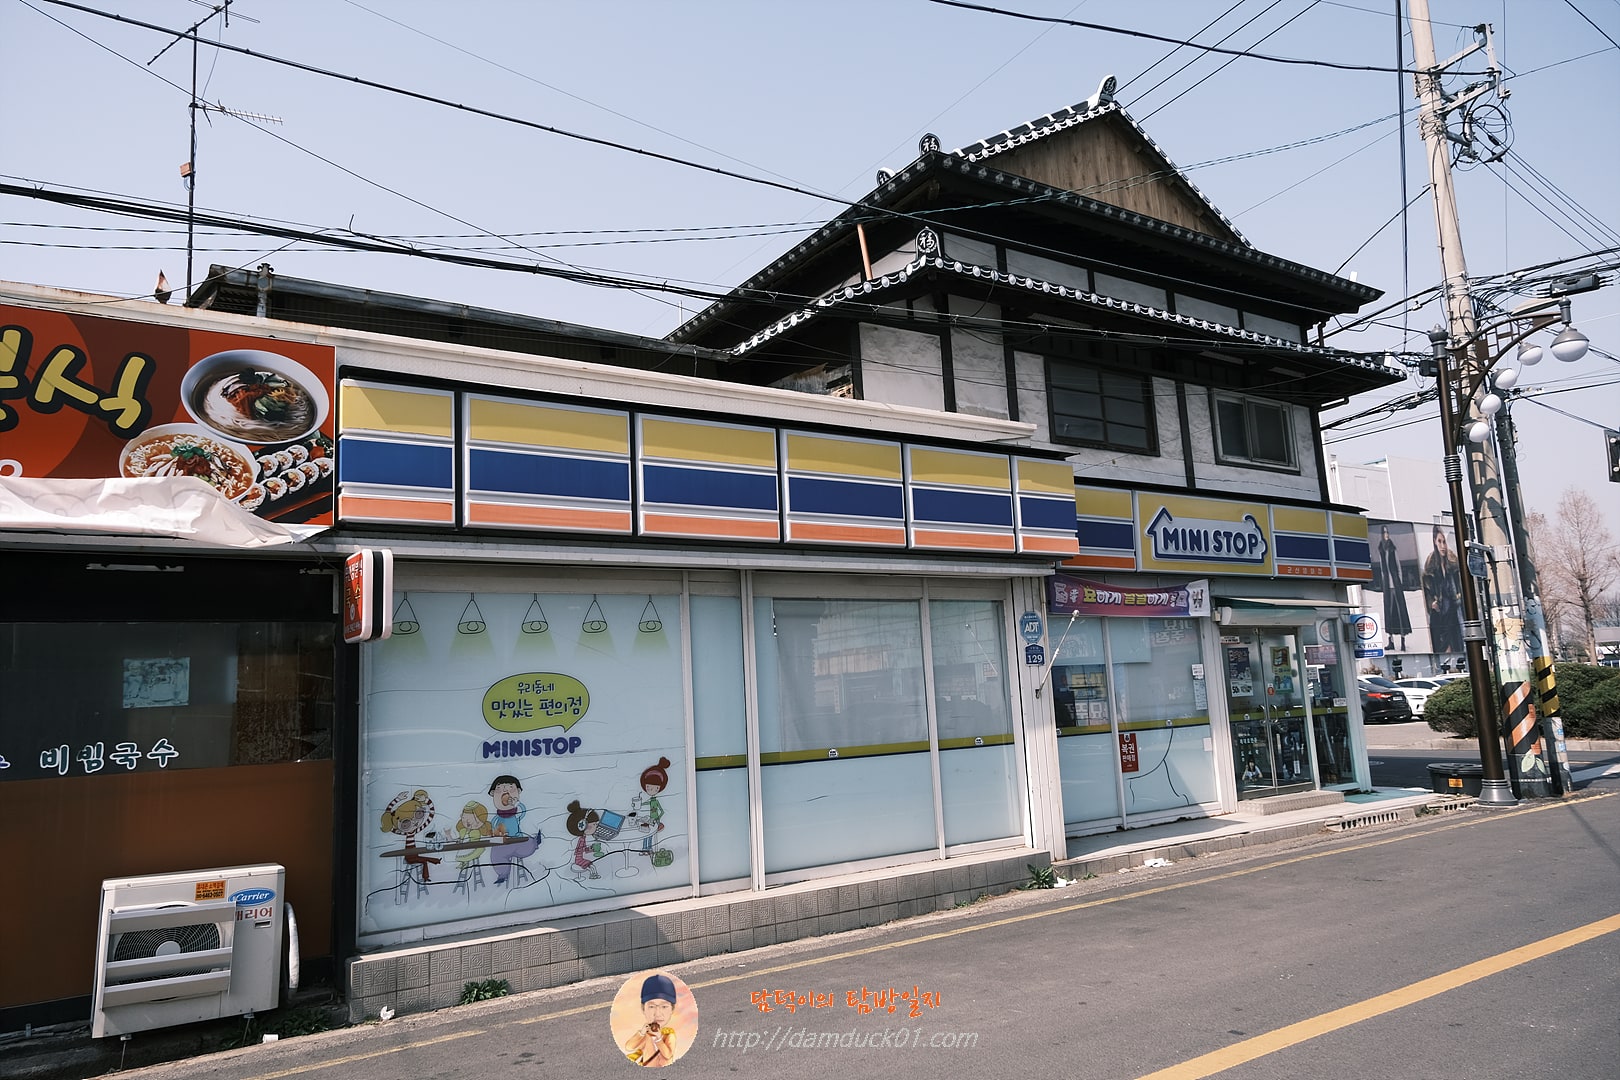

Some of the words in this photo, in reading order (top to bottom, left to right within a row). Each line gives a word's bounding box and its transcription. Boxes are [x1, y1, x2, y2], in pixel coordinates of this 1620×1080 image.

[918, 231, 936, 249] 福
[1162, 525, 1260, 556] MINISTOP
[1024, 621, 1039, 633] ADT
[1027, 654, 1043, 663] 129
[517, 680, 554, 694] 우리동네
[491, 699, 533, 718] 맛있는
[539, 696, 582, 716] 편의점
[39, 738, 180, 775] 비빔국수
[482, 736, 582, 759] MINISTOP
[235, 891, 270, 902] Carrier
